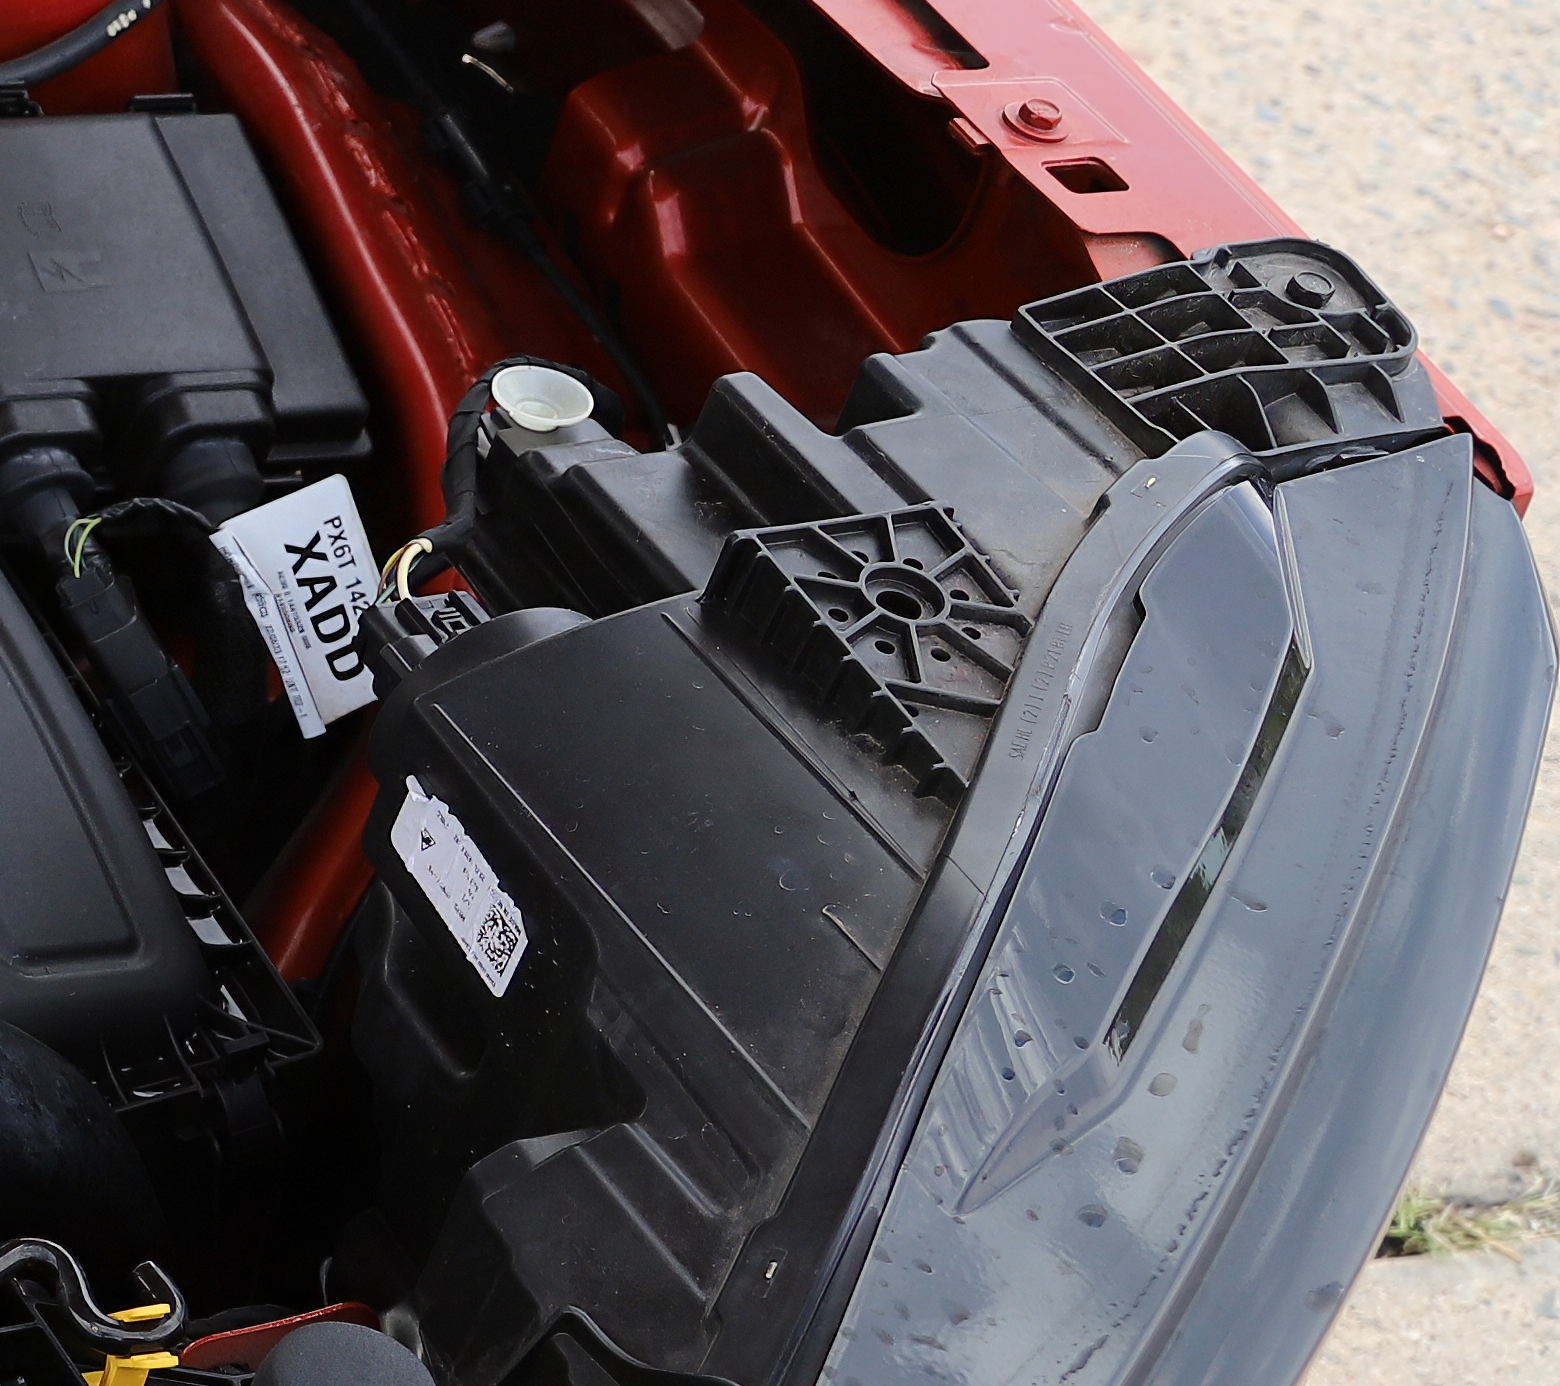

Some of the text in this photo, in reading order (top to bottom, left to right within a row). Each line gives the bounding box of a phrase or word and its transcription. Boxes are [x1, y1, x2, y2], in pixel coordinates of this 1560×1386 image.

[284, 530, 364, 682] XADD
[323, 515, 370, 617] PX6T 142
